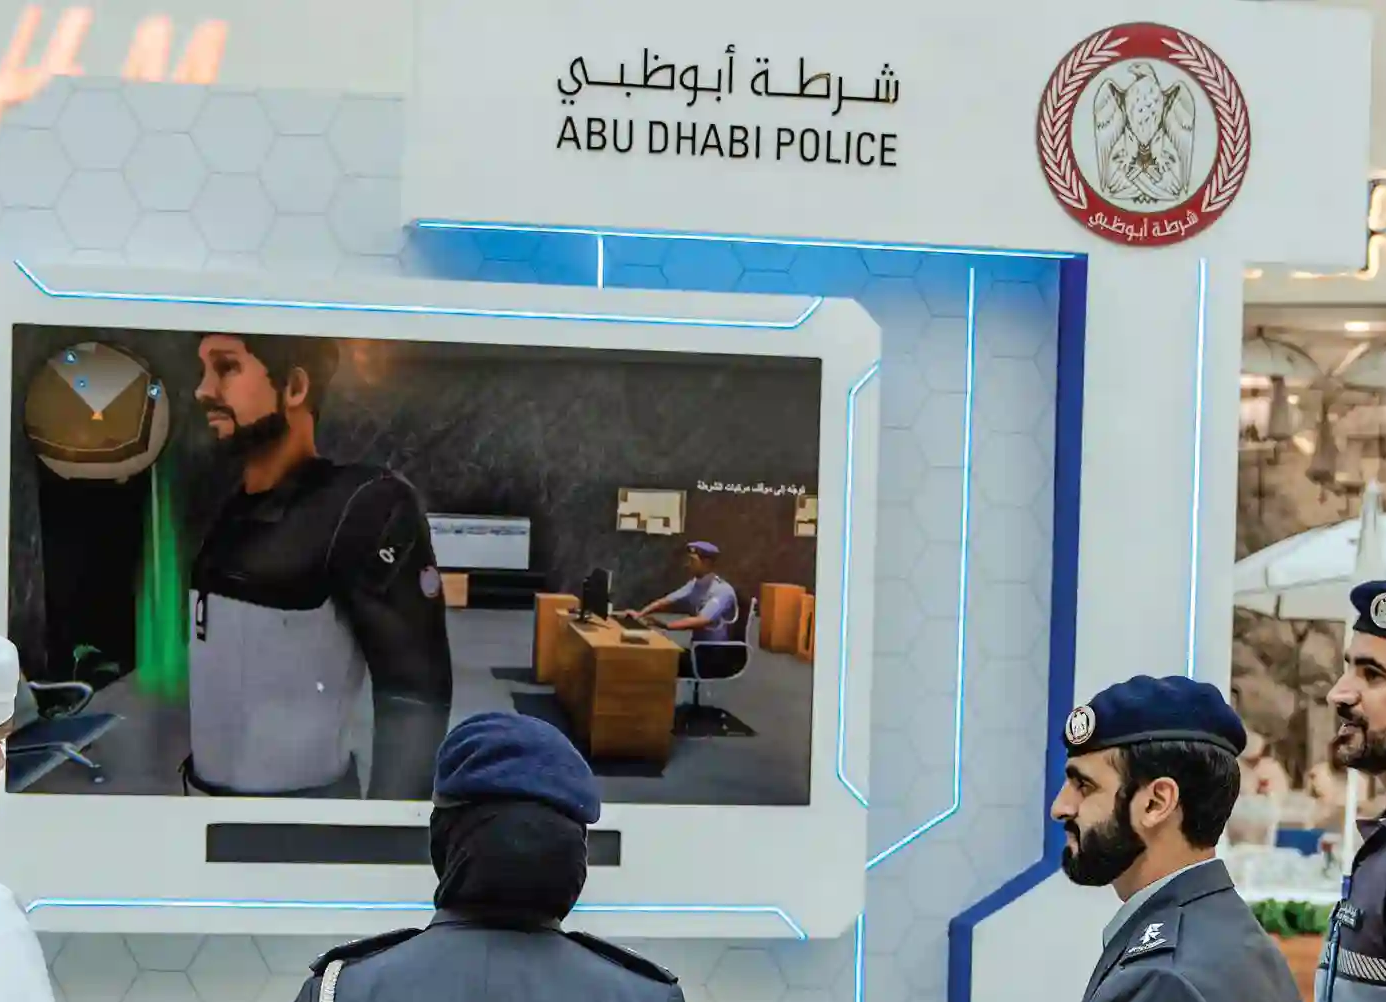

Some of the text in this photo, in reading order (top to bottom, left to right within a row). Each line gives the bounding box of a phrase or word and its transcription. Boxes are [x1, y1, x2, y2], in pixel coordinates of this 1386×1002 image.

[557, 43, 899, 116] شرطة أبوظبي
[556, 115, 898, 167] ABU DHABI POLICE
[1087, 209, 1200, 242] شرطة أبوظبي
